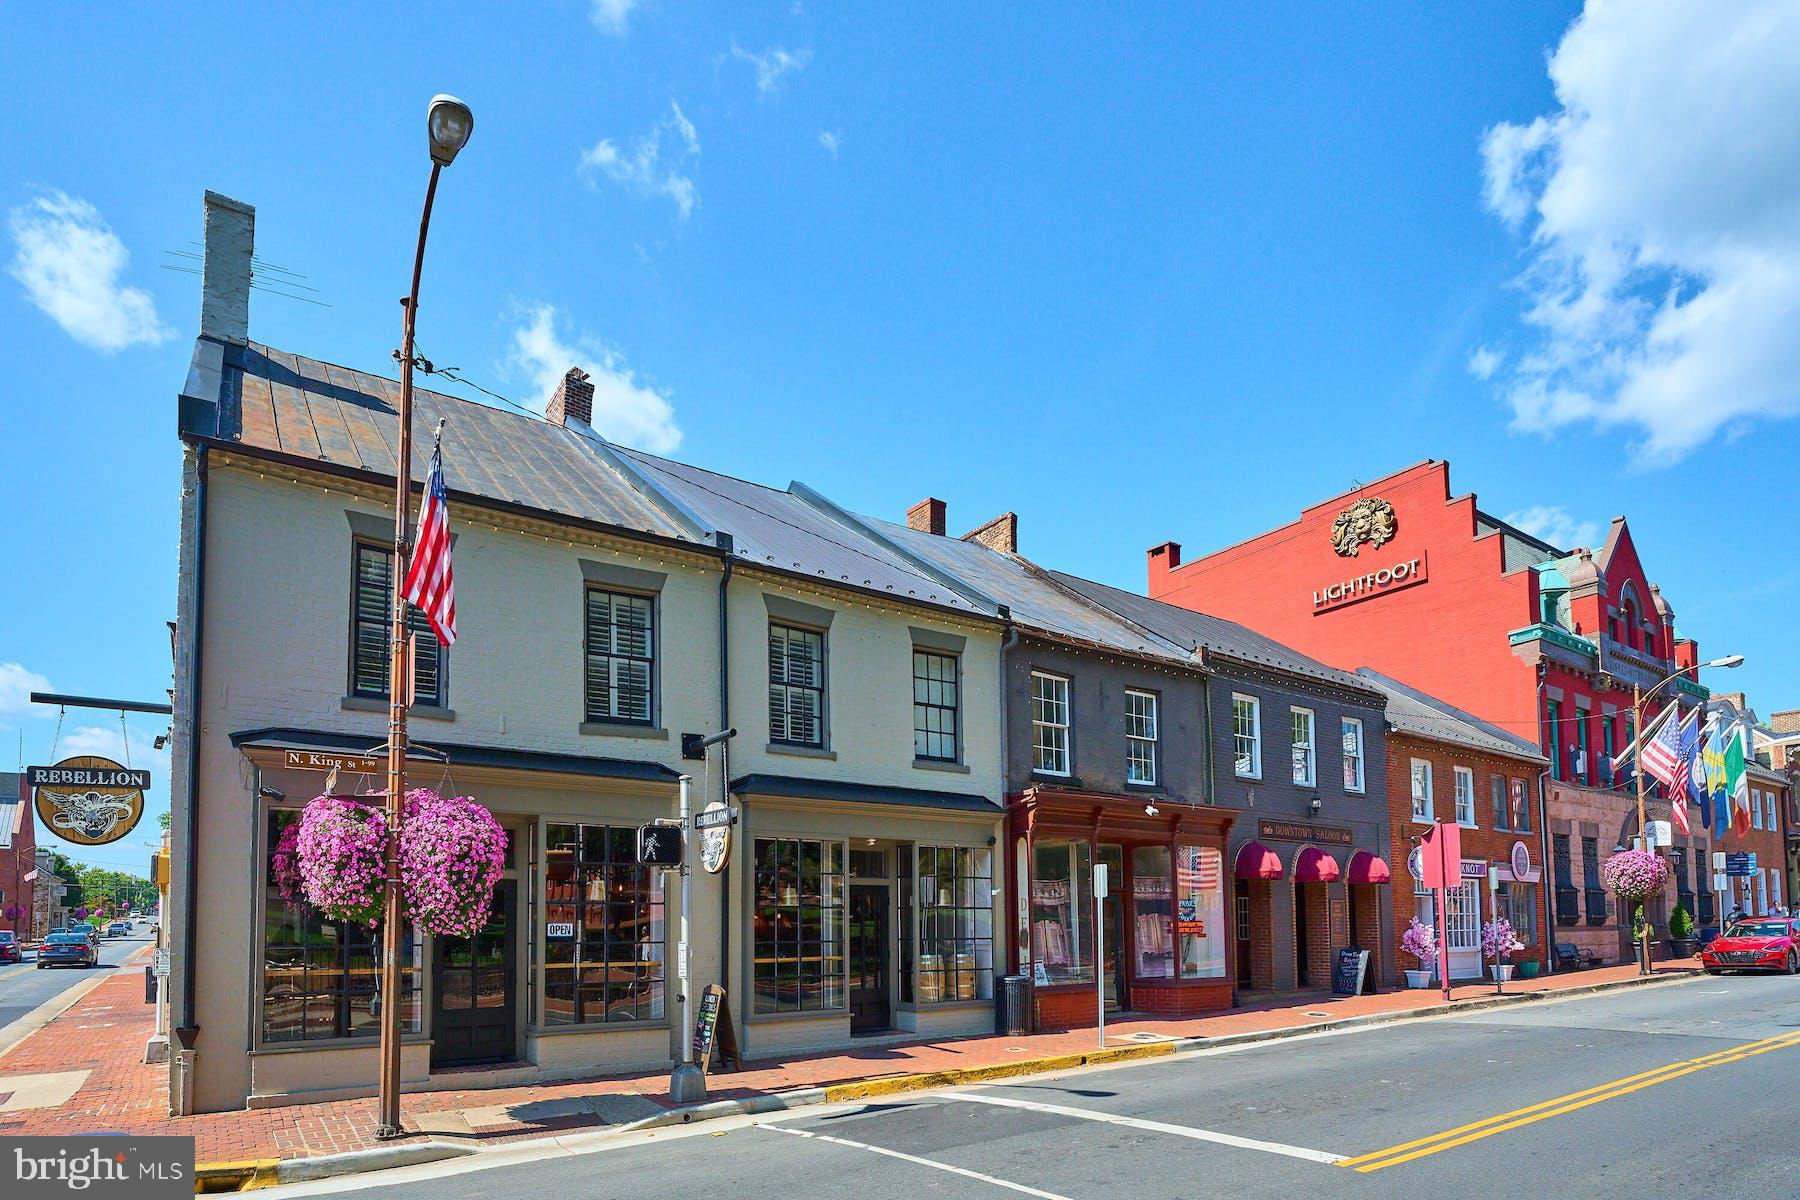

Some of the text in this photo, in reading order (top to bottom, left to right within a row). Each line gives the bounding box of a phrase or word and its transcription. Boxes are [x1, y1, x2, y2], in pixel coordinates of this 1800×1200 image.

[1313, 559, 1419, 604] LIGHTFOOT
[289, 752, 304, 764] N.
[309, 754, 342, 770] King
[347, 760, 356, 769] St
[34, 769, 143, 786] REBELLION
[1275, 825, 1341, 841] DOWNTOWN SALOON
[549, 924, 571, 935] OPEN
